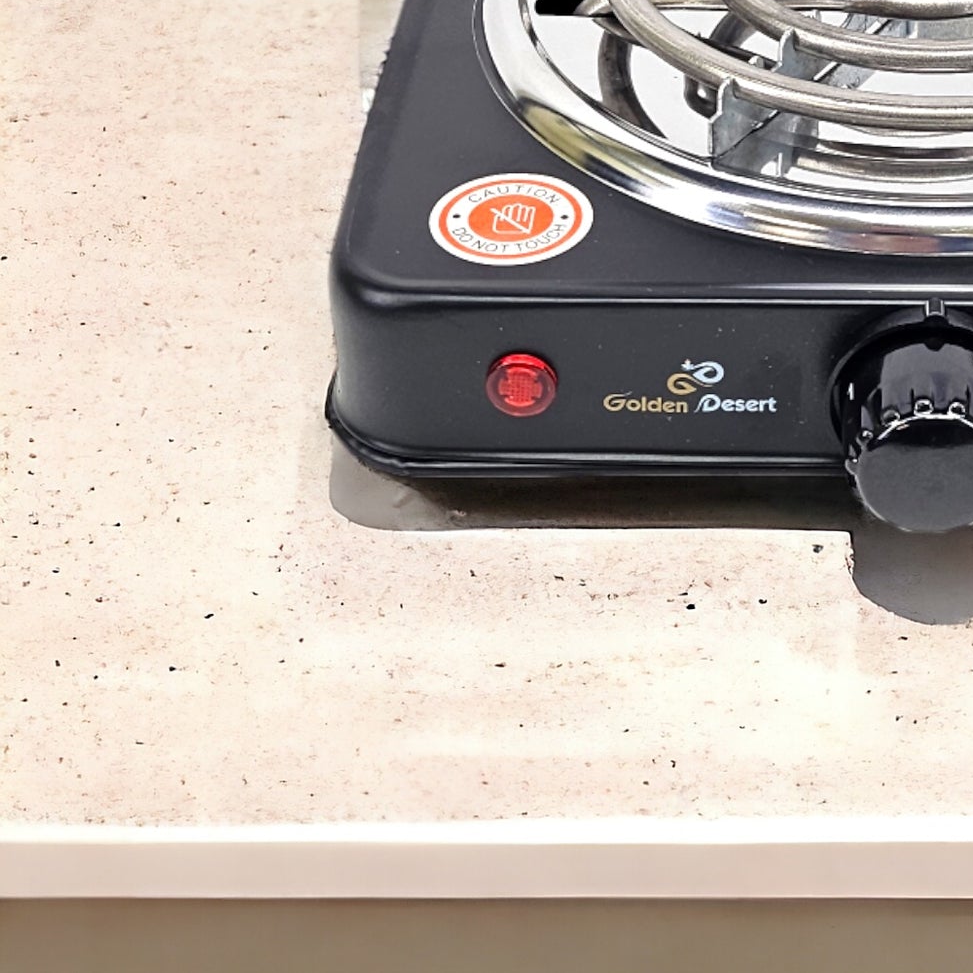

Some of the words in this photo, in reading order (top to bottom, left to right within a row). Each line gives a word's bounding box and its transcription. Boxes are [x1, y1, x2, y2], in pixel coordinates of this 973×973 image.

[468, 184, 561, 204] CAUTION
[452, 227, 474, 243] DO
[471, 240, 511, 253] NOT
[513, 223, 568, 252] TOUCH
[602, 391, 689, 413] Golden
[694, 393, 778, 413] Desert
